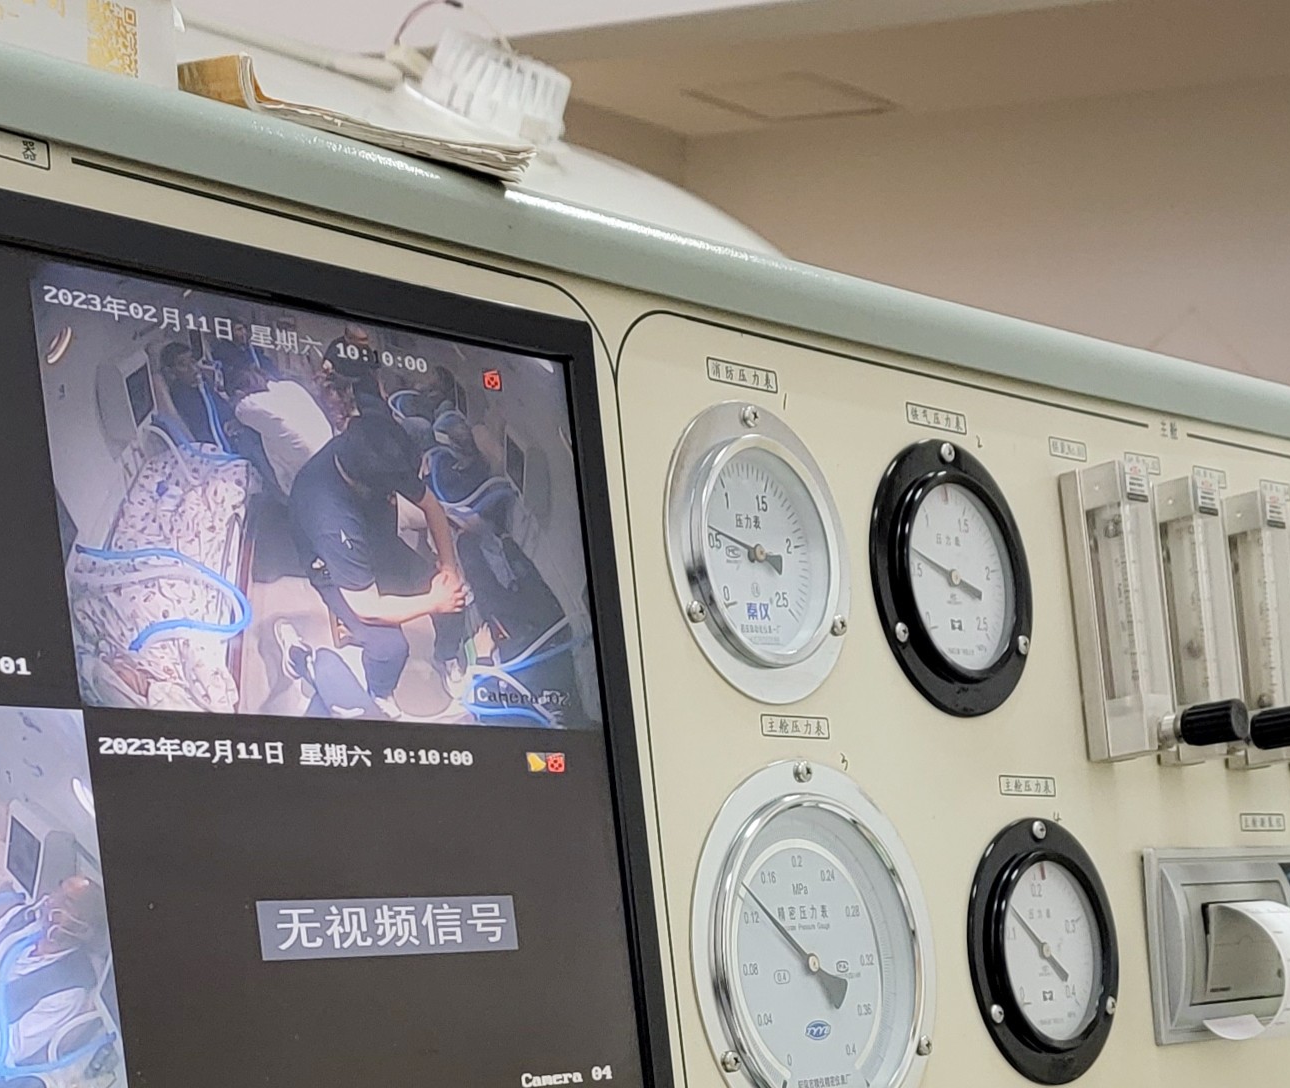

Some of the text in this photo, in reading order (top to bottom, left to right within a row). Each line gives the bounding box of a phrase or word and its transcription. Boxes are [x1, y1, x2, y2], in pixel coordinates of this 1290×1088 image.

[43, 285, 233, 341] 2023年02月11日
[250, 324, 323, 358] 星期六
[711, 361, 774, 390] 消防压力表
[735, 513, 762, 530] 压力表
[0, 656, 33, 677] 01
[766, 718, 826, 737] 主舱压力表
[98, 736, 473, 767] 2023年02月11日 星期六 10:10:00
[1004, 778, 1053, 795] 主舱压力表
[792, 883, 809, 895] MPa
[778, 904, 829, 921] 精密压力表
[277, 903, 507, 951] 无视频信号
[742, 963, 759, 976] 0.08
[757, 1013, 772, 1027] 0.04
[845, 1043, 857, 1056] 0.4
[521, 1065, 613, 1088] Camera 04
